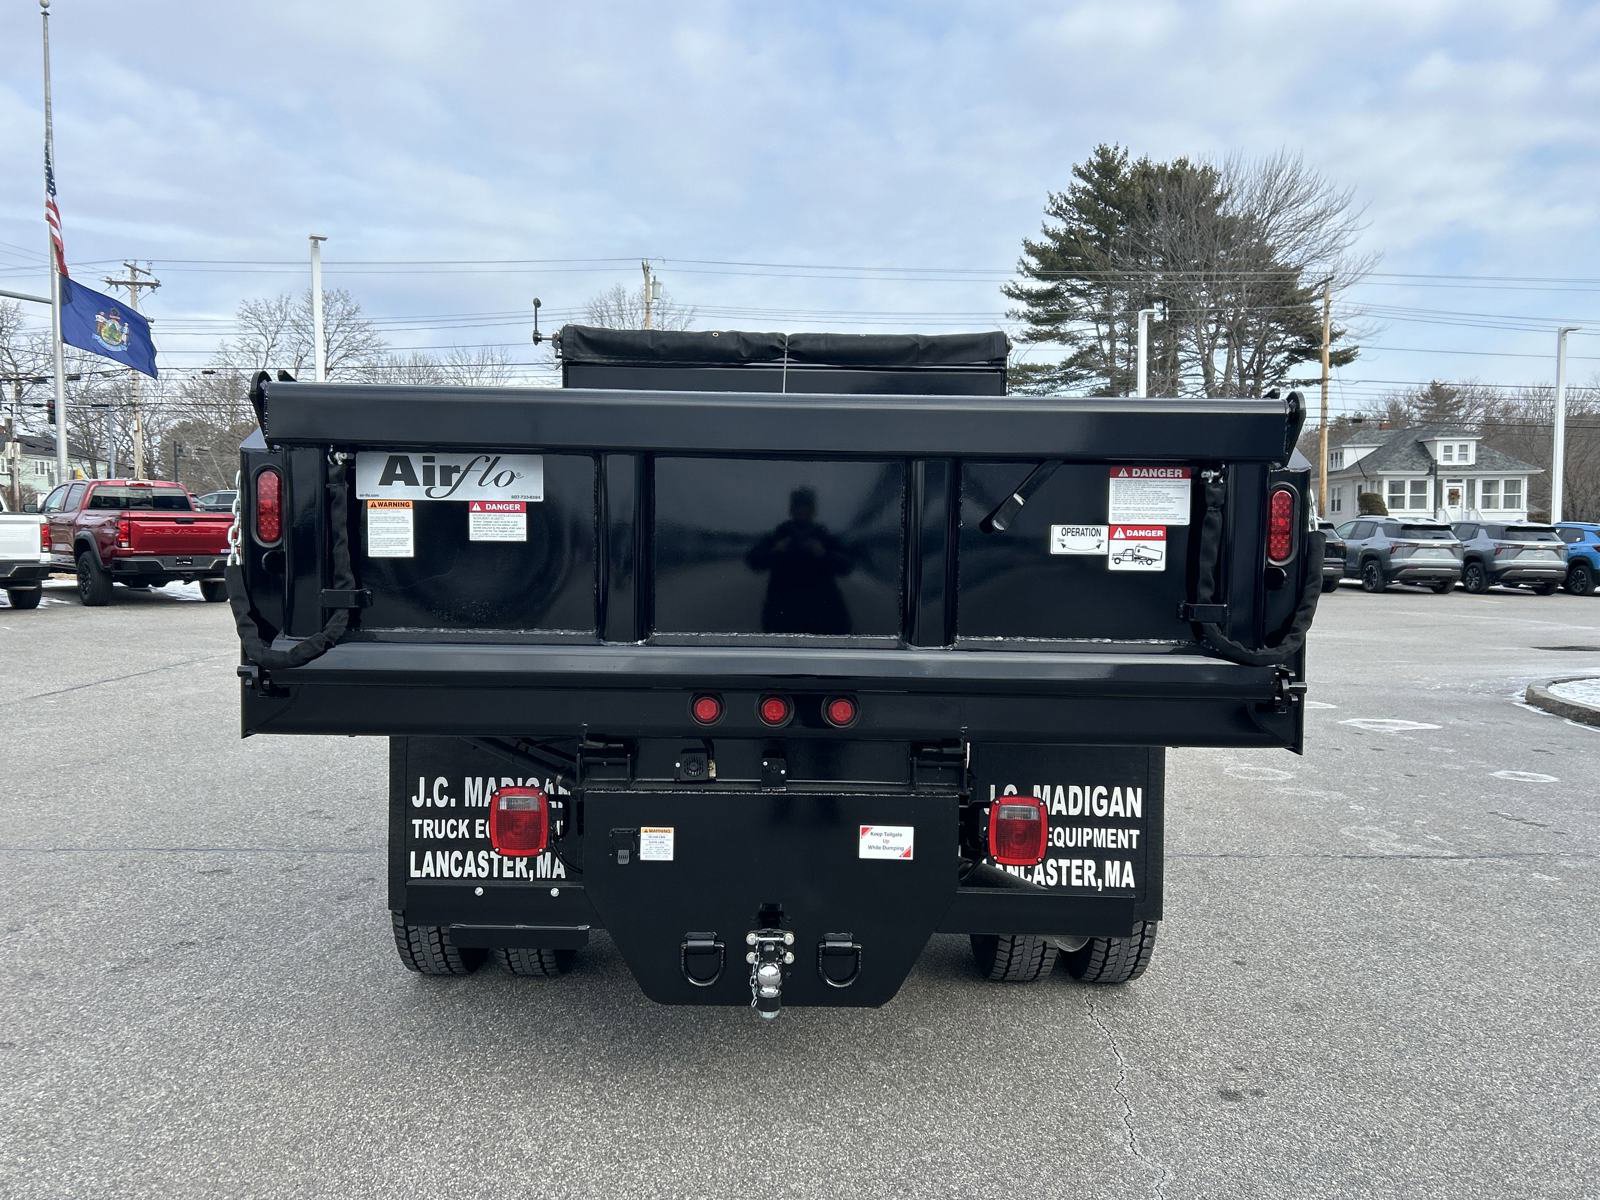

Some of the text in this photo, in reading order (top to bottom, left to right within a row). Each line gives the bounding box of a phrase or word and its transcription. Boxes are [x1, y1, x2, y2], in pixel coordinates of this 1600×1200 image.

[378, 455, 524, 499] Airflo
[1132, 468, 1183, 478] DANGER
[485, 503, 521, 511] DANGER
[1061, 527, 1102, 537] OPERATION
[1126, 529, 1164, 537] DANGER
[411, 776, 456, 808] J.C.
[1033, 784, 1143, 818] MADIGAN
[411, 819, 470, 839] TRUCK
[410, 850, 566, 882] LANCASTER,MA
